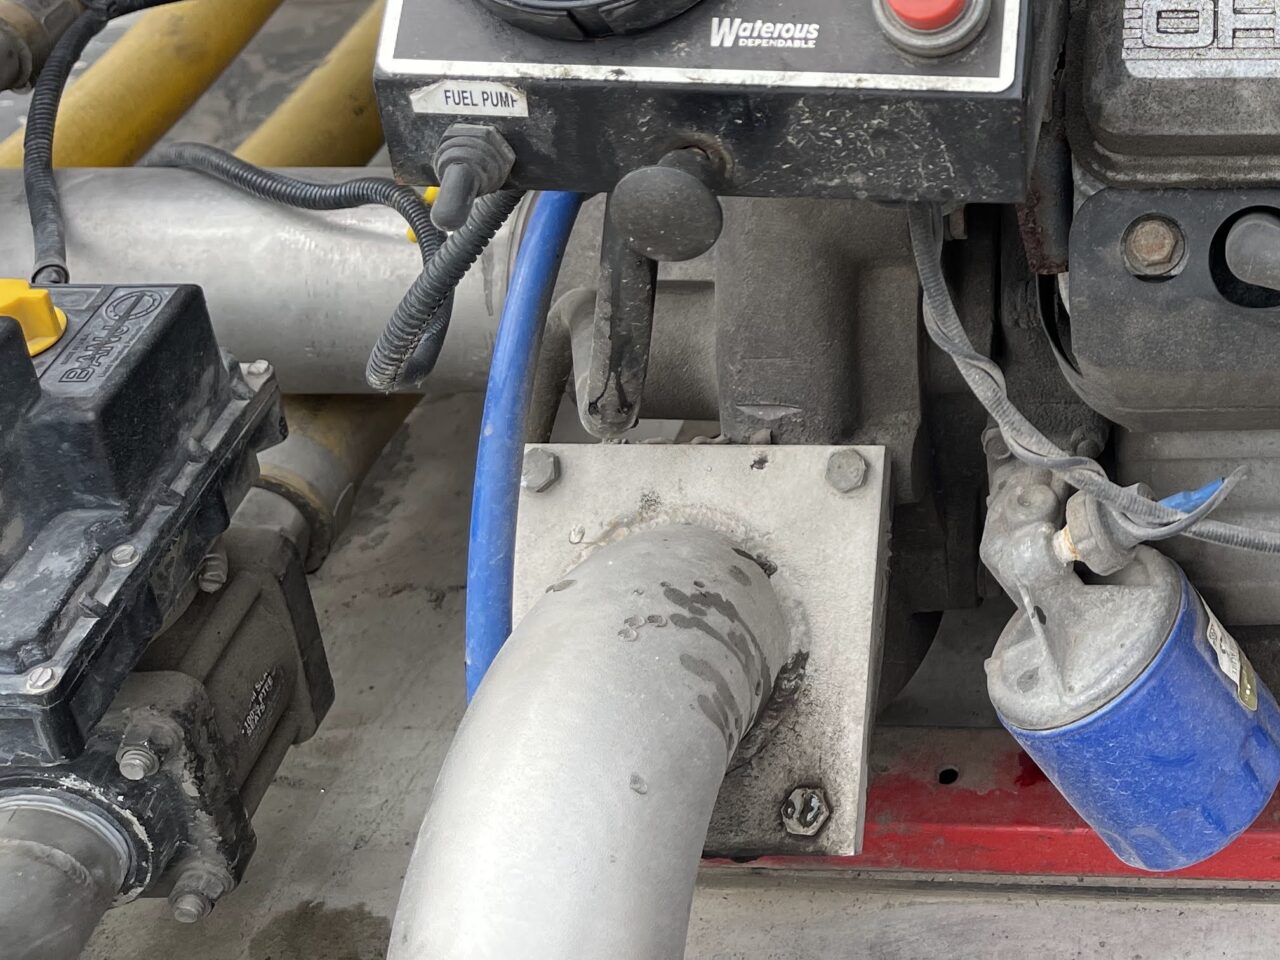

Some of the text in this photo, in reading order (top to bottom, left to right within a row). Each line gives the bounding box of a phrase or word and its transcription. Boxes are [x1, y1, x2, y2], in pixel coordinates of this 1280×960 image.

[710, 17, 820, 47] Waterous
[738, 38, 816, 48] DEPENDABLE
[444, 89, 478, 106] FUEL
